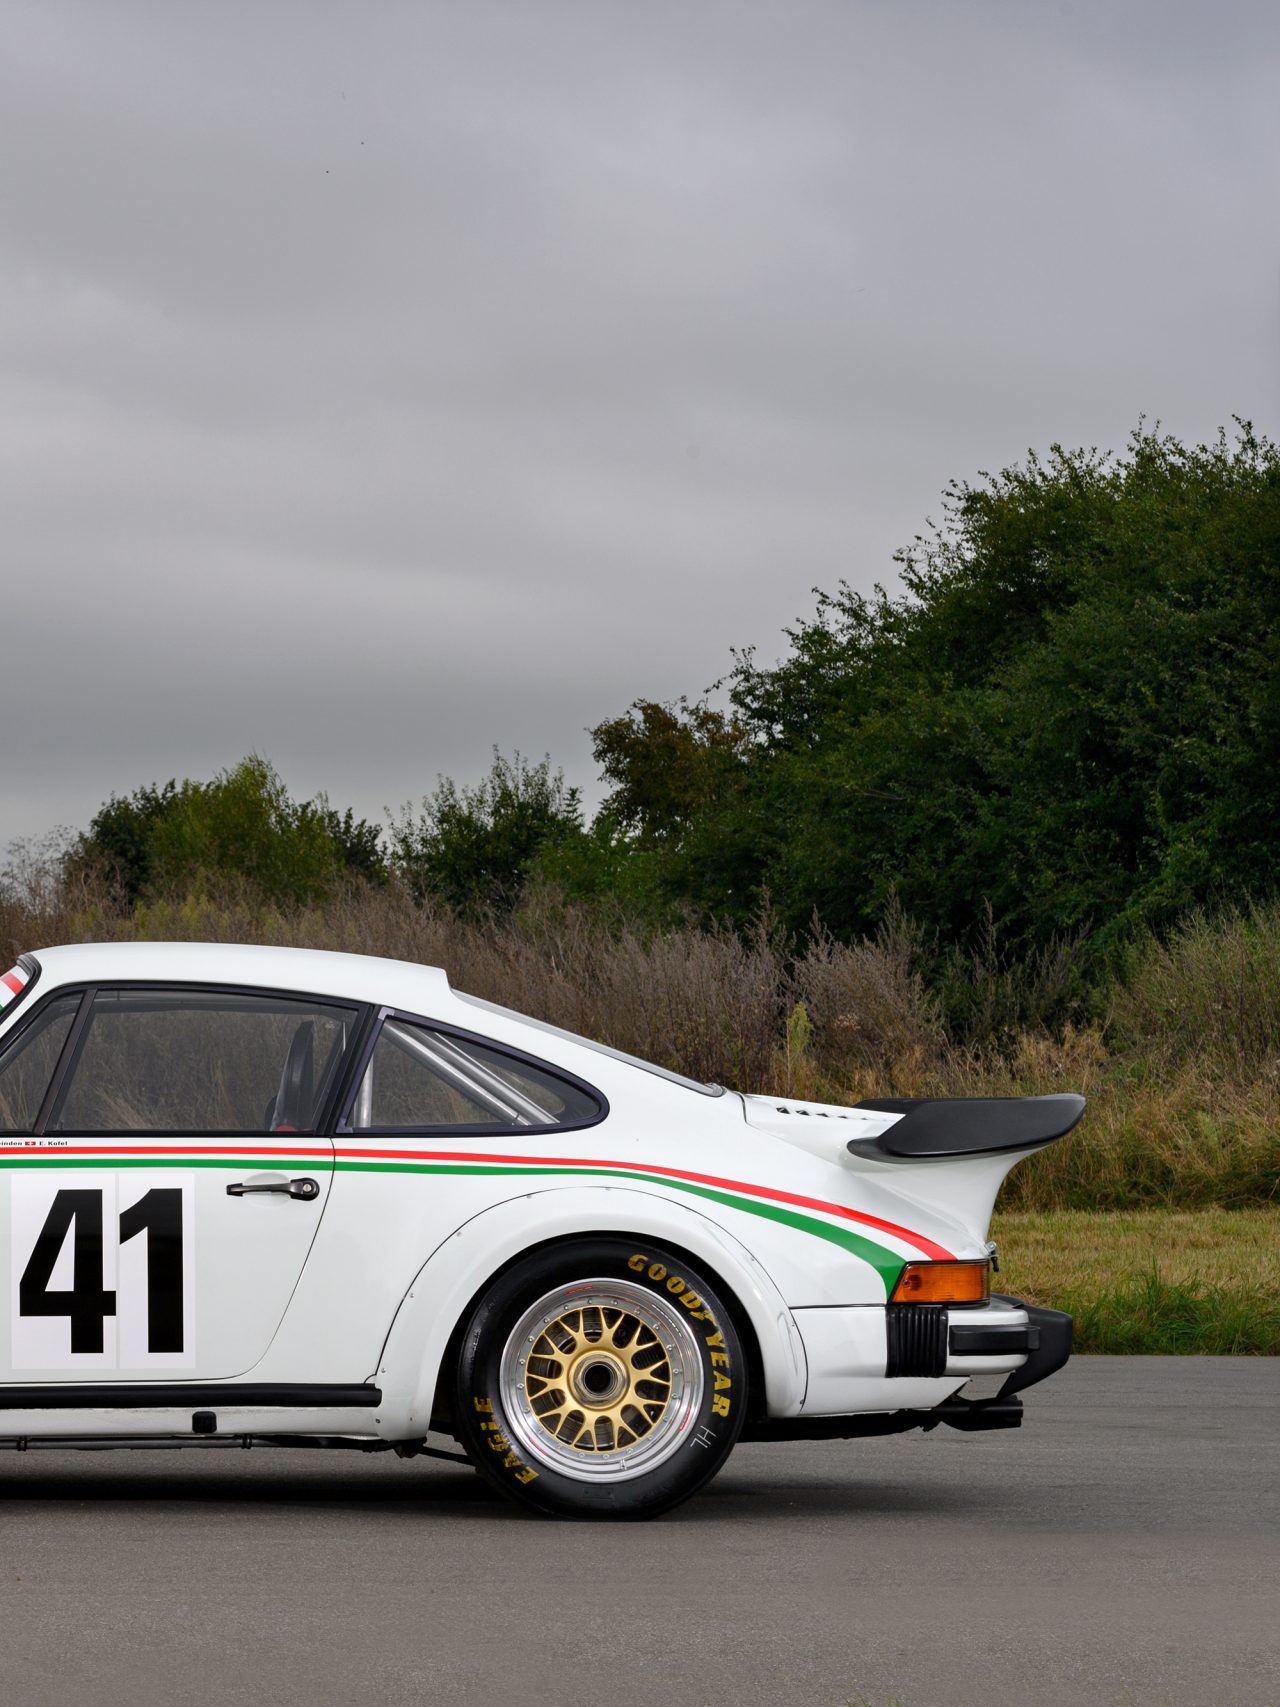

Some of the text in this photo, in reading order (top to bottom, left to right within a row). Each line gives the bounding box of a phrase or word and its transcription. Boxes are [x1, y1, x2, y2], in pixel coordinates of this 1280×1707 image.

[19, 1188, 184, 1353] 41
[627, 1254, 732, 1417] GOODYEAR
[690, 1425, 717, 1449] HL
